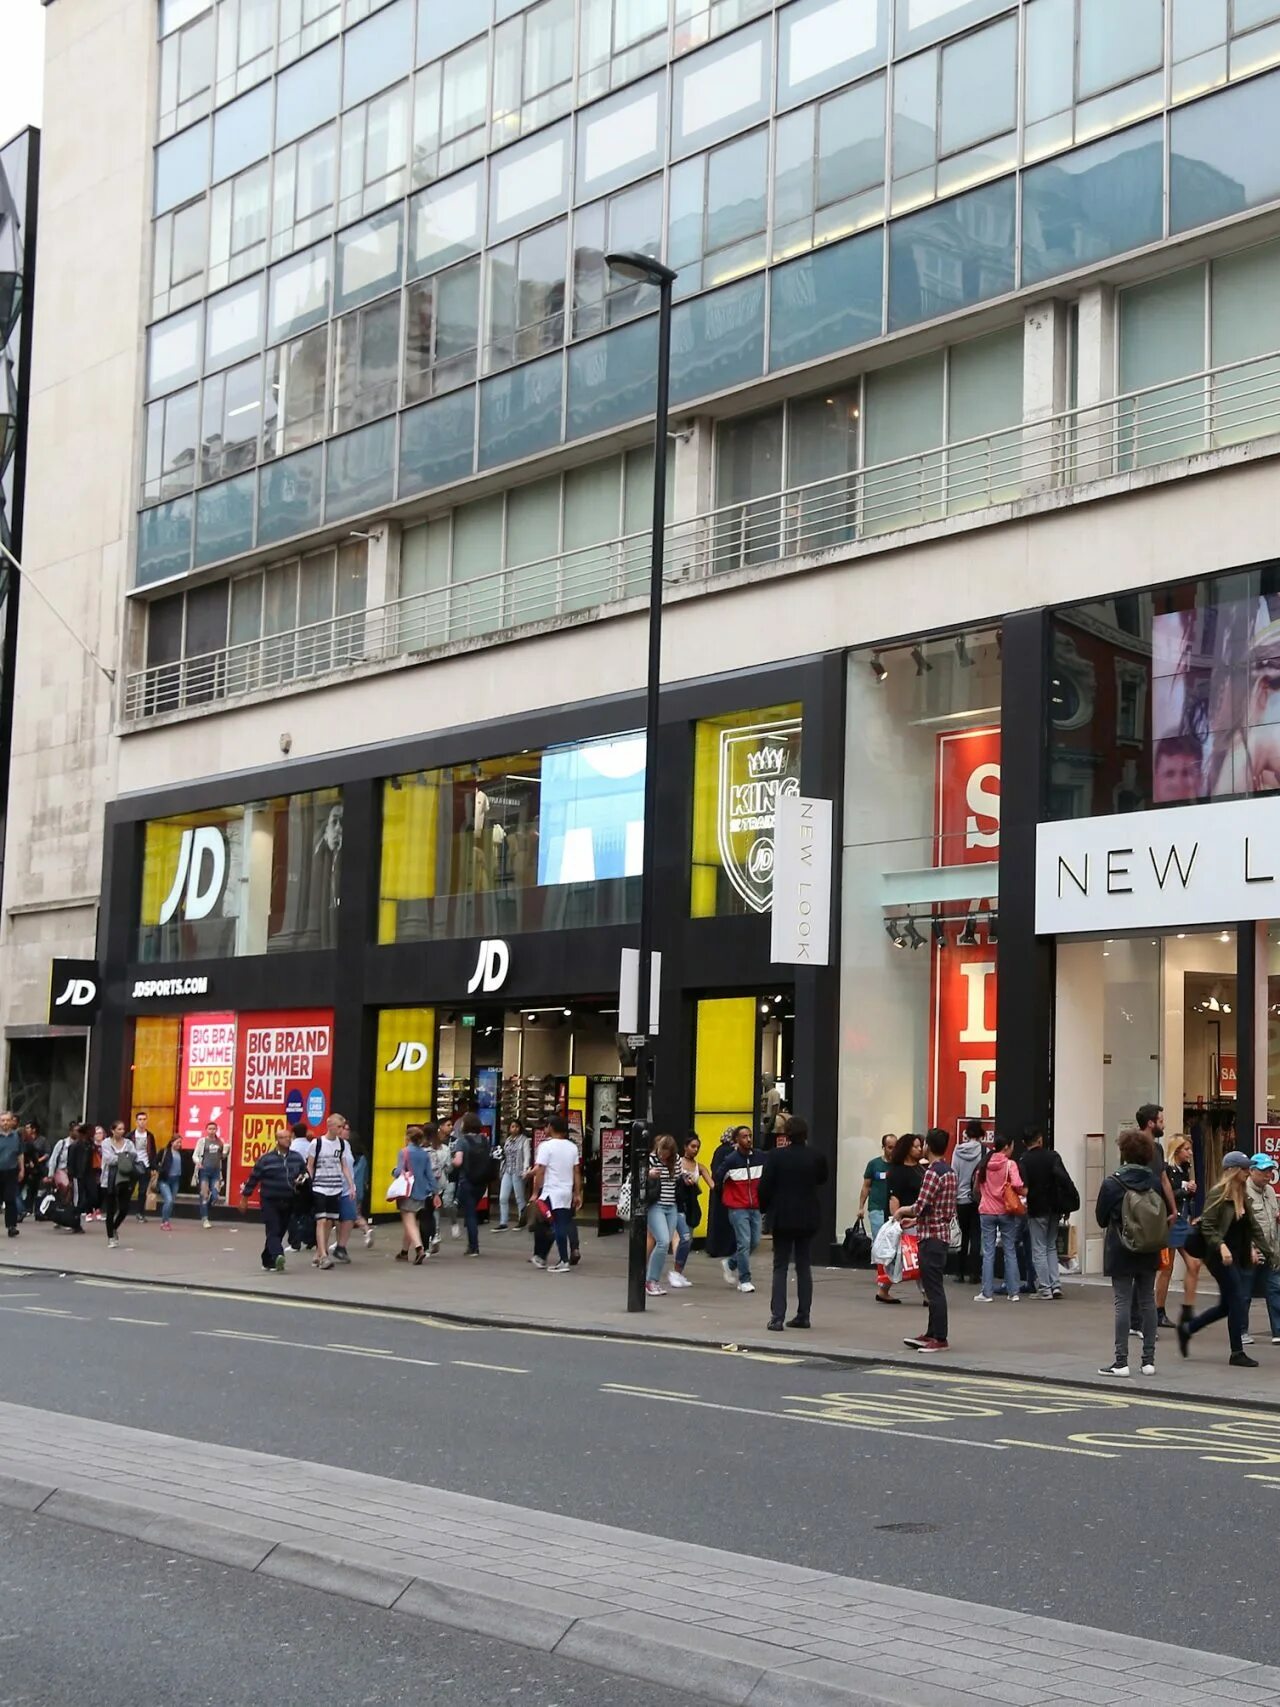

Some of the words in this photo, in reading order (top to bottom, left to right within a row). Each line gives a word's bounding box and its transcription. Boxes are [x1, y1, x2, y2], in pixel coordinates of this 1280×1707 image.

[801, 803, 813, 866] NEW
[160, 826, 226, 925] JD
[1058, 842, 1199, 898] NEW
[798, 883, 811, 958] LOOK
[467, 939, 509, 994] JD
[55, 979, 97, 1006] JD
[132, 977, 208, 998] JDSPORTS.COM
[193, 1028, 209, 1044] BIG
[249, 1033, 271, 1053] BIG
[275, 1030, 327, 1052] BRAND
[191, 1045, 234, 1063] SUMME
[247, 1055, 310, 1077] SUMMER
[386, 1042, 428, 1072] JD
[190, 1070, 204, 1087] UP
[206, 1069, 220, 1085] TO
[246, 1079, 282, 1100] SALE
[245, 1119, 263, 1140] UP
[781, 1387, 1130, 1425] STOP
